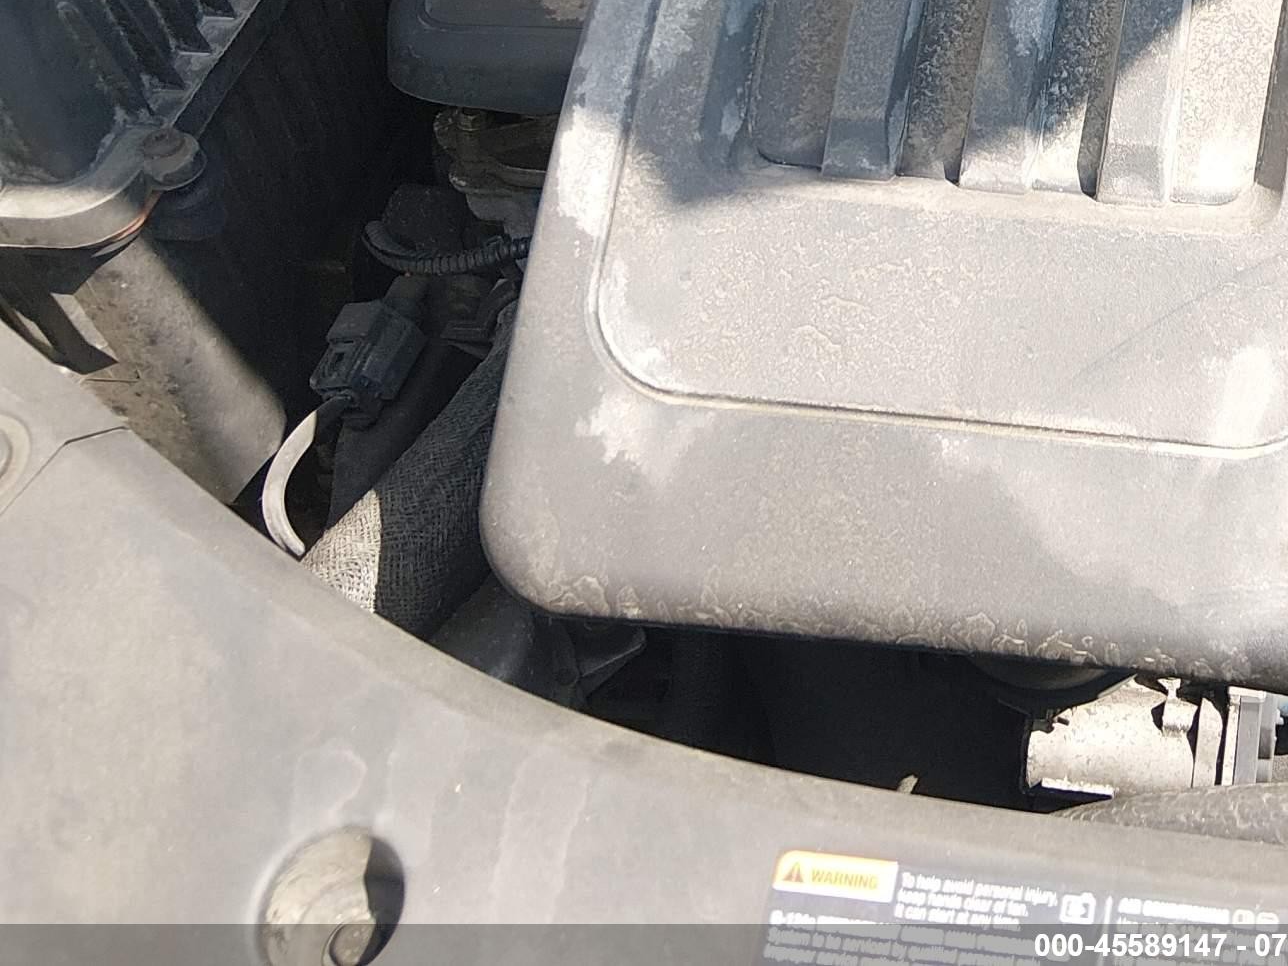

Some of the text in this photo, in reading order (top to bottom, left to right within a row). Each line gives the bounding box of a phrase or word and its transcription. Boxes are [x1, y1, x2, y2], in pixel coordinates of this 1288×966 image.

[811, 868, 878, 890] WARNING
[901, 872, 915, 889] To
[916, 874, 942, 893] help
